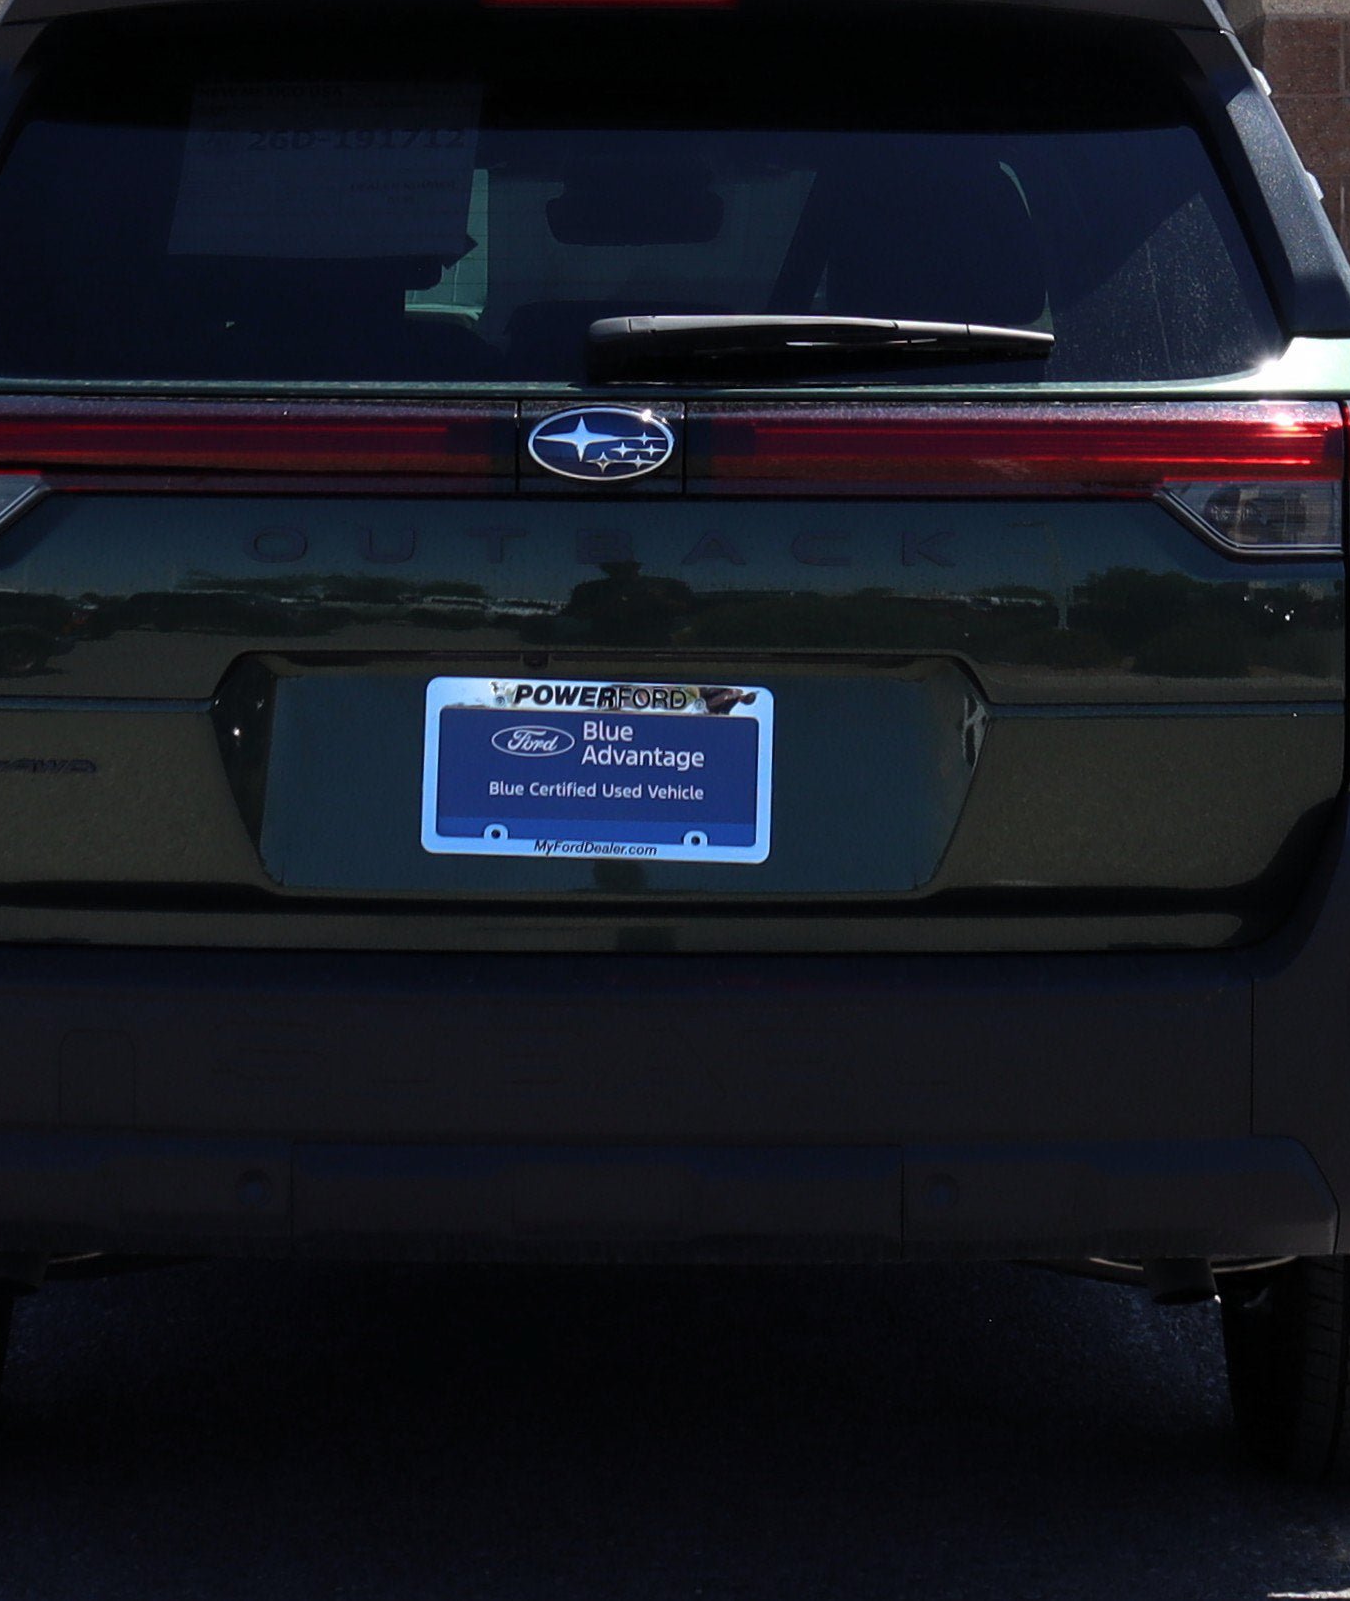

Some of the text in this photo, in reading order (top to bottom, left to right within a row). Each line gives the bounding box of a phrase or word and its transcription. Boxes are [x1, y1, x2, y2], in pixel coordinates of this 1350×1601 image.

[250, 524, 958, 568] OUTBACK
[506, 728, 560, 753] Ford
[582, 720, 634, 743] Blue
[580, 744, 705, 771] Advantage
[489, 781, 704, 801] Blue Certified Used Vehicle
[533, 839, 658, 856] MyFordDealer.com
